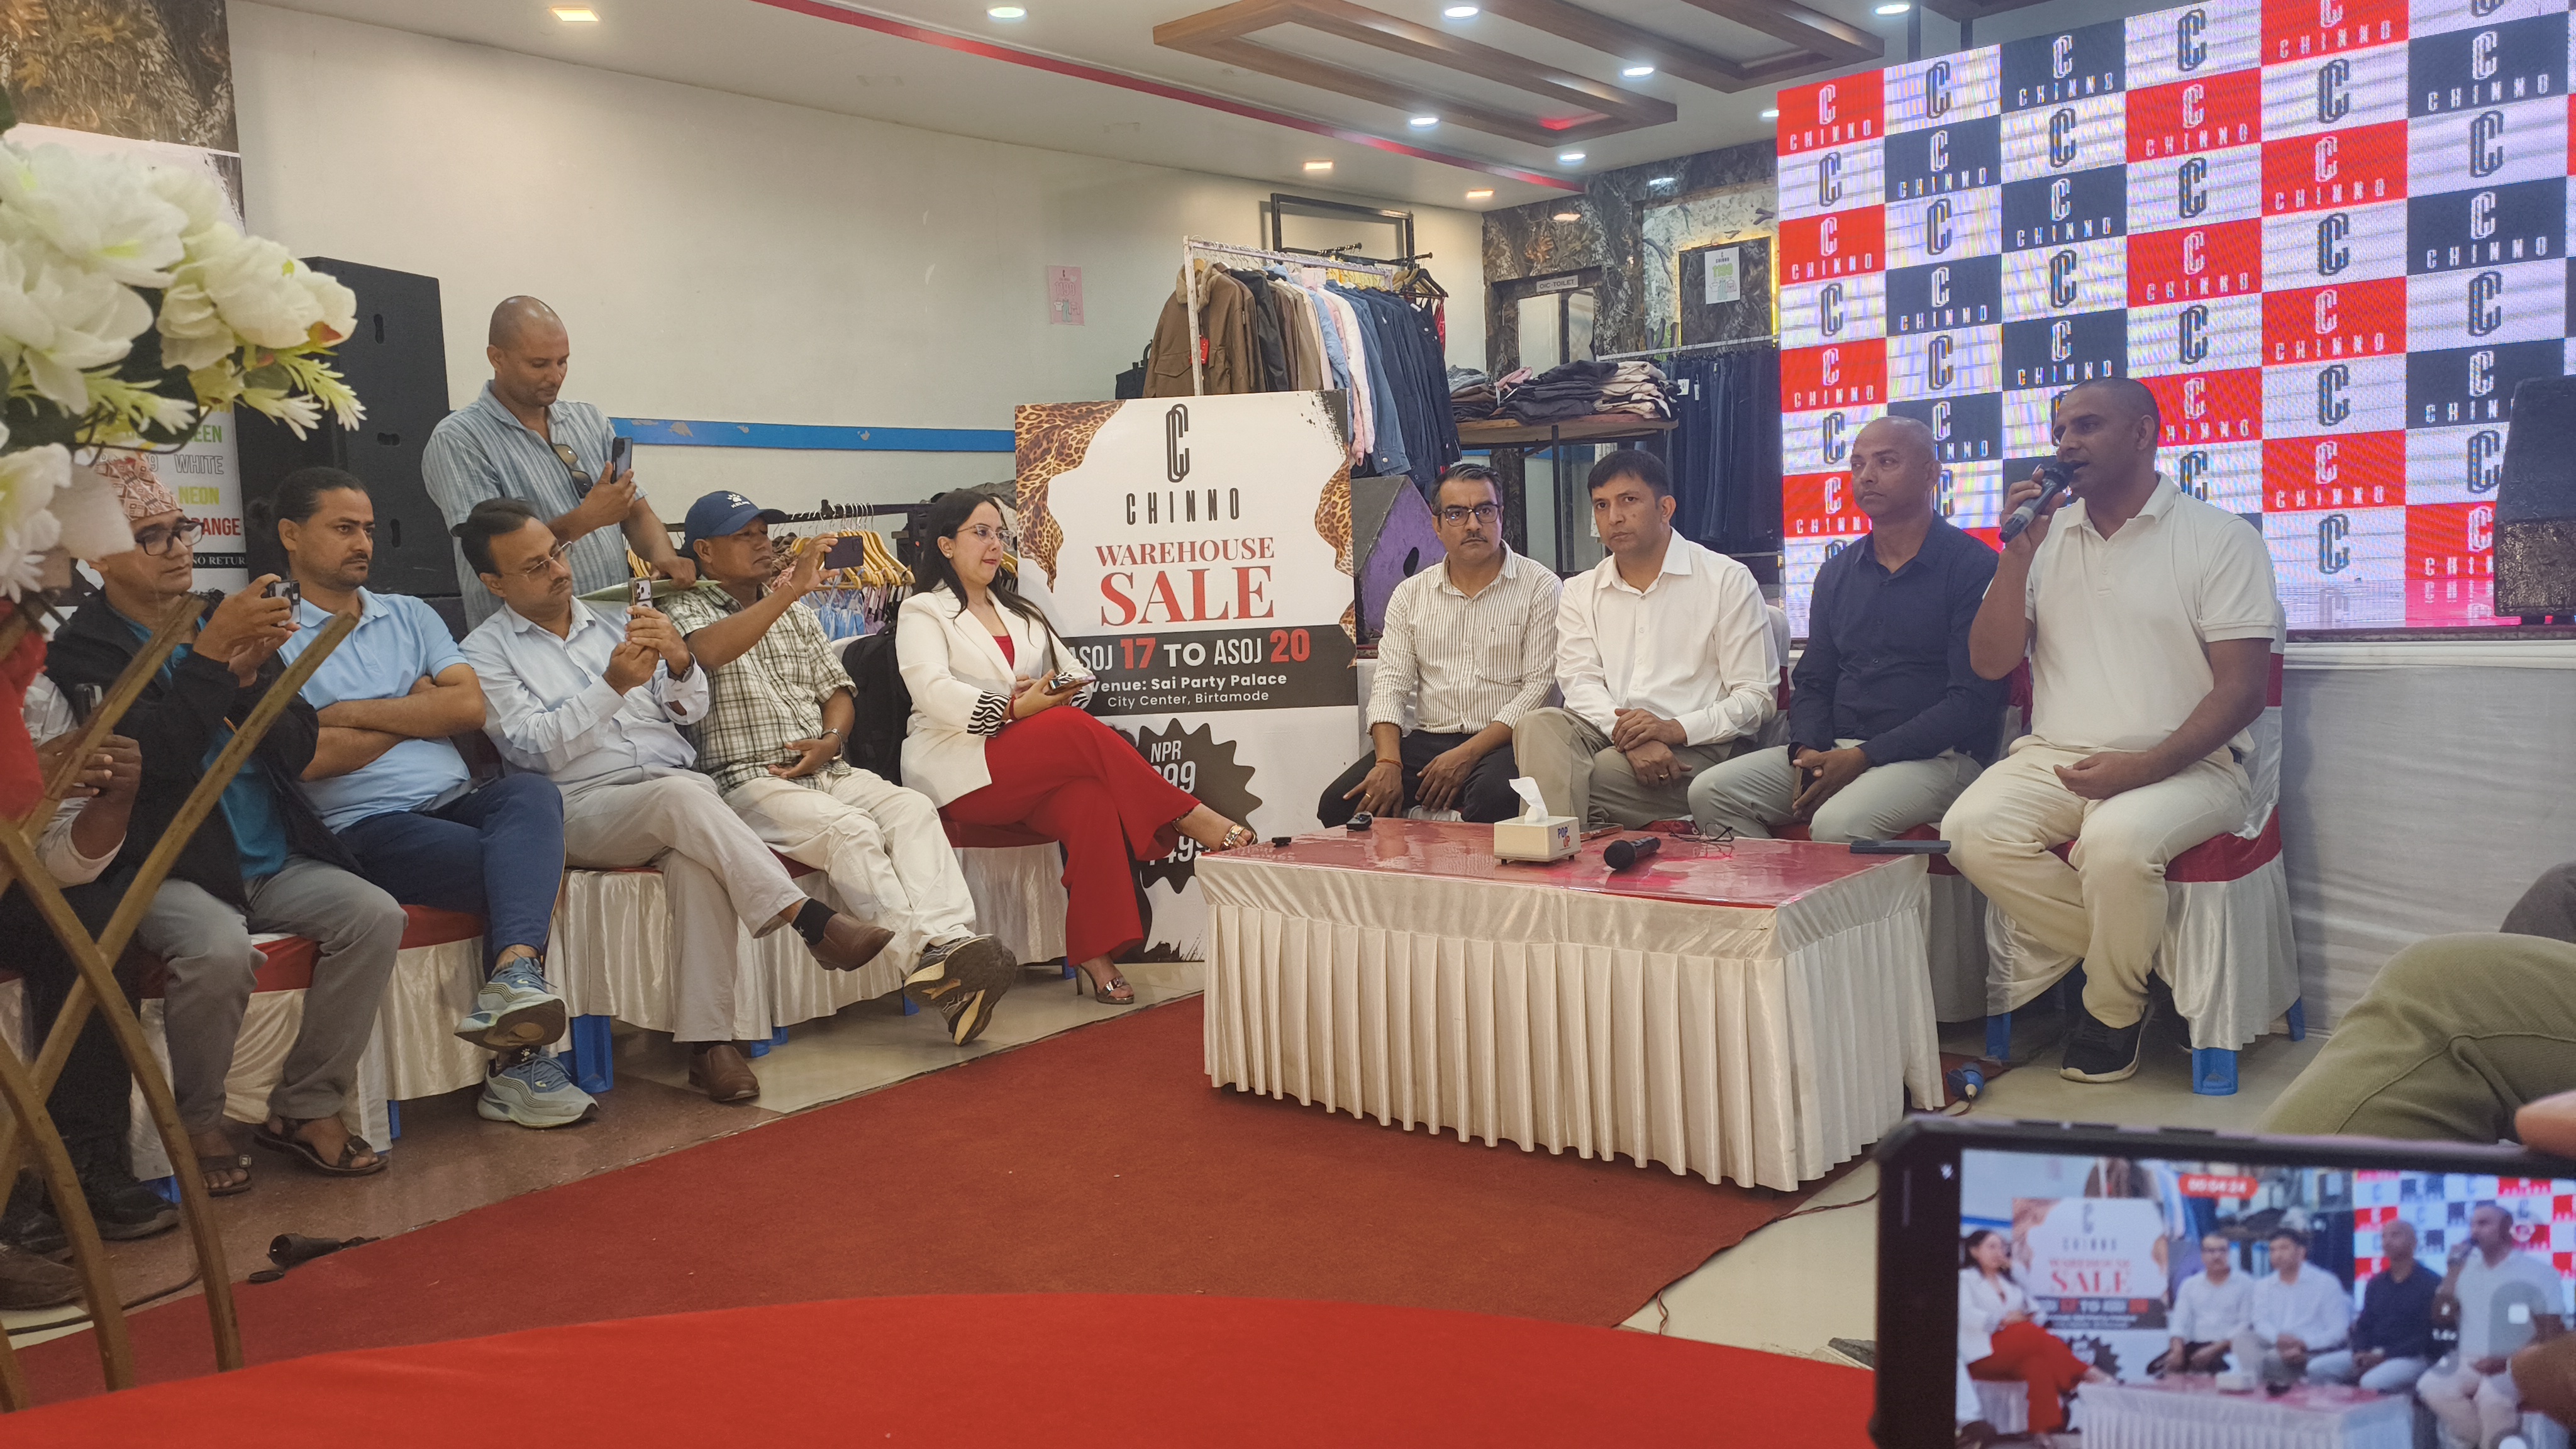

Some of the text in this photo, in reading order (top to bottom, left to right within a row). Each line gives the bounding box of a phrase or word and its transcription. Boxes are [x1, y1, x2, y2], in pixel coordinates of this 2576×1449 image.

[2280, 19, 2390, 58] CHINNO
[2019, 72, 2114, 107] CHINNO
[2428, 75, 2549, 111] CHINNO
[1790, 119, 1872, 150] CHINNO
[2146, 123, 2248, 157] CHINNO
[1898, 167, 1987, 198] CHINNO
[2275, 179, 2385, 211] CHINNO
[2017, 217, 2111, 248] CHINNO
[2426, 236, 2548, 269] CHINNO
[1792, 253, 1872, 280] CHINNO
[2146, 272, 2249, 301] CHINNO
[1900, 304, 1988, 331] CHINNO
[2276, 333, 2384, 361] CHINNO
[2018, 360, 2112, 386] CHINNO
[1794, 385, 1874, 408] CHINNO
[2426, 398, 2515, 423] CHIN
[2167, 419, 2250, 441] HINNO
[1935, 440, 1989, 460] INNO
[174, 455, 224, 475] WHITE
[179, 486, 219, 504] NEON
[1126, 487, 1240, 525] CHINNO
[2276, 486, 2385, 508] CHINNO
[191, 518, 242, 536] ANGE
[1096, 537, 1274, 567] WAREHOUSE
[1101, 566, 1274, 626] SALE
[1120, 638, 1156, 669] 17
[1163, 643, 1206, 667] TO
[1214, 638, 1262, 665] ASOJ
[1269, 629, 1310, 663] 20
[1151, 676, 1176, 691] Sai
[1181, 676, 1226, 691] Party
[1231, 673, 1287, 687] Palace
[1108, 691, 1269, 709] City Center, Birtamode
[1150, 740, 1182, 763] NPR
[1558, 826, 1568, 839] POP
[1563, 836, 1570, 847] UP
